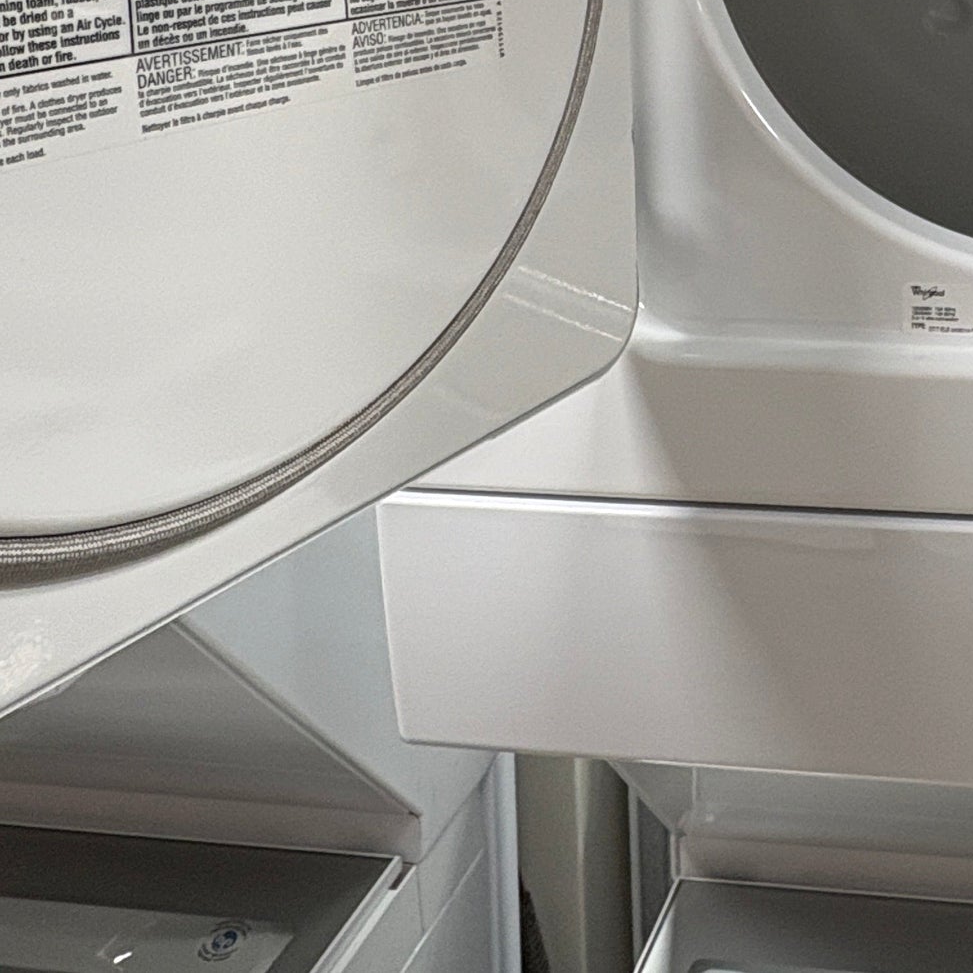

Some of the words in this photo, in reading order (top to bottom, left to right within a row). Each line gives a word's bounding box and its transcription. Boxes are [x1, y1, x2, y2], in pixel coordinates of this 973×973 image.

[2, 15, 17, 27] be
[19, 9, 48, 25] dried
[51, 8, 65, 21] on
[67, 8, 74, 19] a
[12, 28, 25, 43] by
[28, 24, 58, 38] using
[60, 21, 75, 34] an
[76, 17, 92, 32] Air
[94, 14, 127, 31] Cycle.
[351, 12, 425, 37] ADVERTENCIA:
[27, 39, 58, 53] these
[60, 29, 121, 48] instructions
[352, 32, 388, 49] AVISO:
[8, 57, 39, 72] death
[41, 54, 53, 66] or
[55, 50, 77, 63] fire.
[137, 65, 197, 90] DANGER:
[1, 105, 13, 117] of
[29, 100, 37, 111] A
[66, 92, 88, 106] dryer
